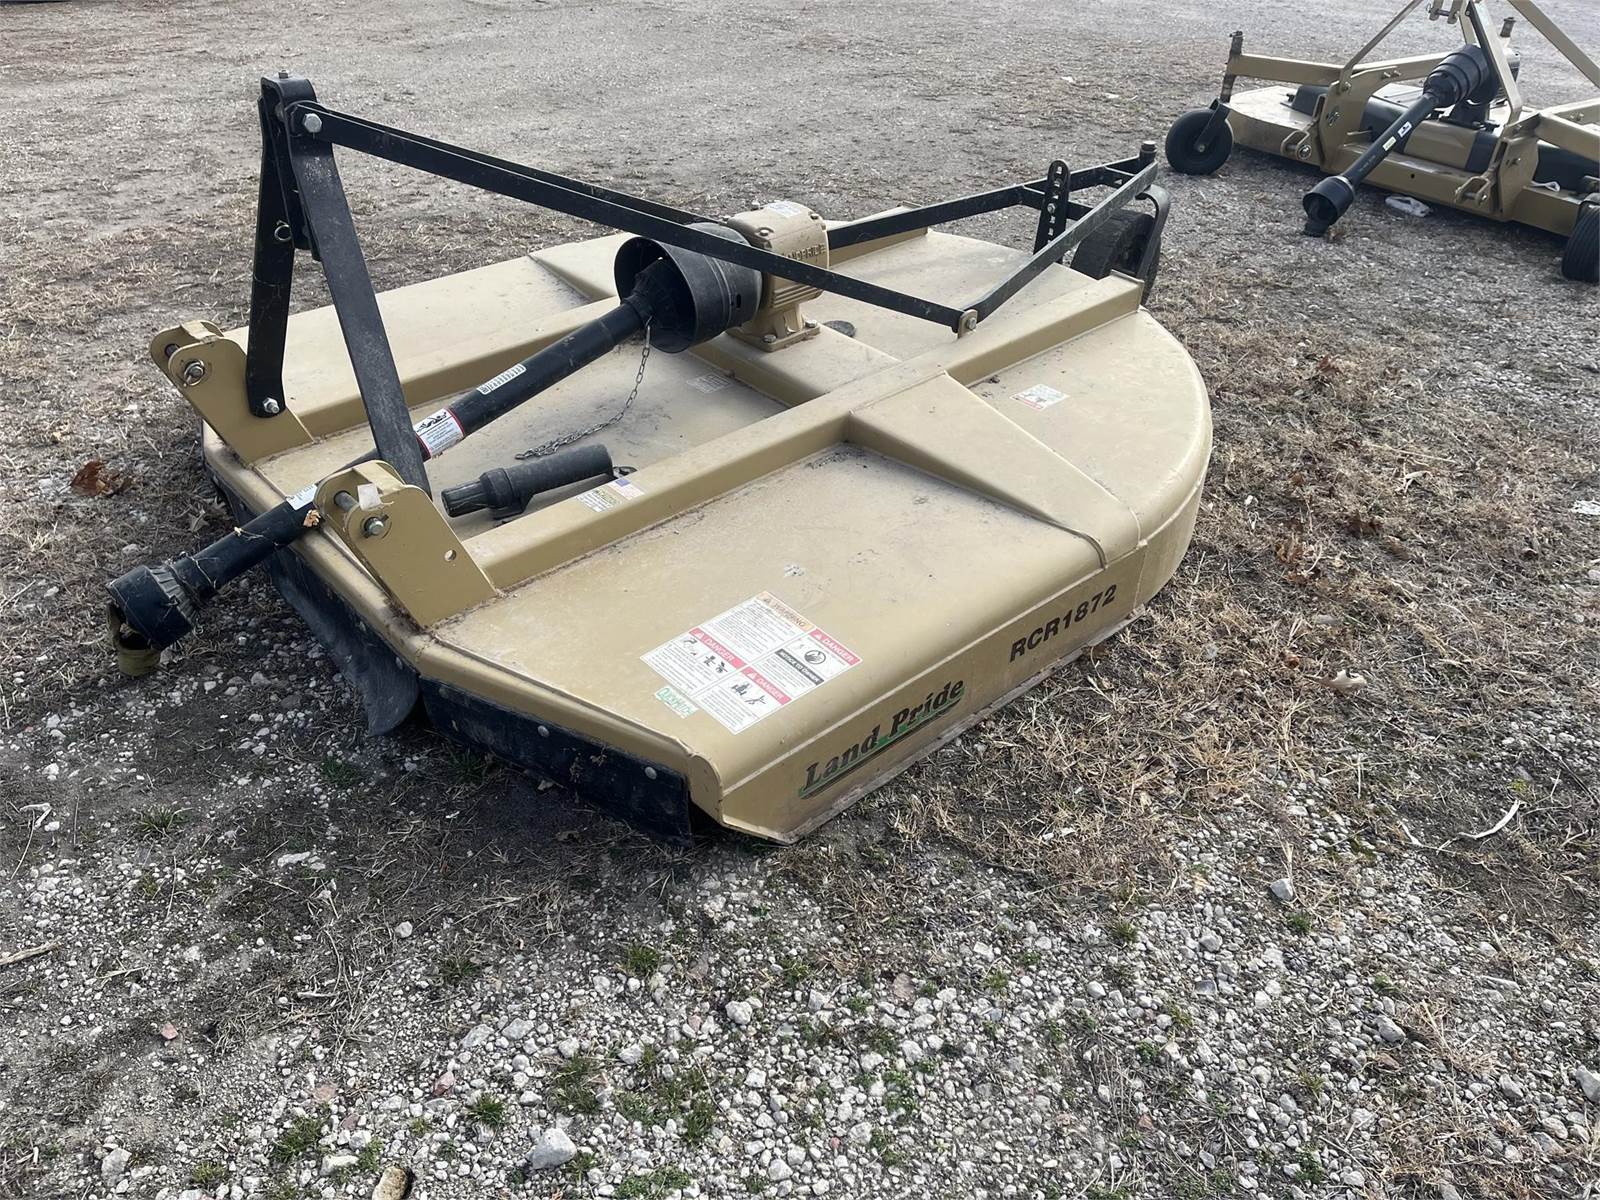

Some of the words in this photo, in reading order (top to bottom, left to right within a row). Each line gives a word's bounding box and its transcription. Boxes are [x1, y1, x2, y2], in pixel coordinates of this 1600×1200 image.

[1009, 584, 1117, 663] RCR1872
[703, 637, 735, 662] DANGER
[822, 637, 855, 662] DANGER
[754, 677, 785, 701] DANGER
[802, 724, 881, 791] Land
[888, 679, 965, 737] Pride
